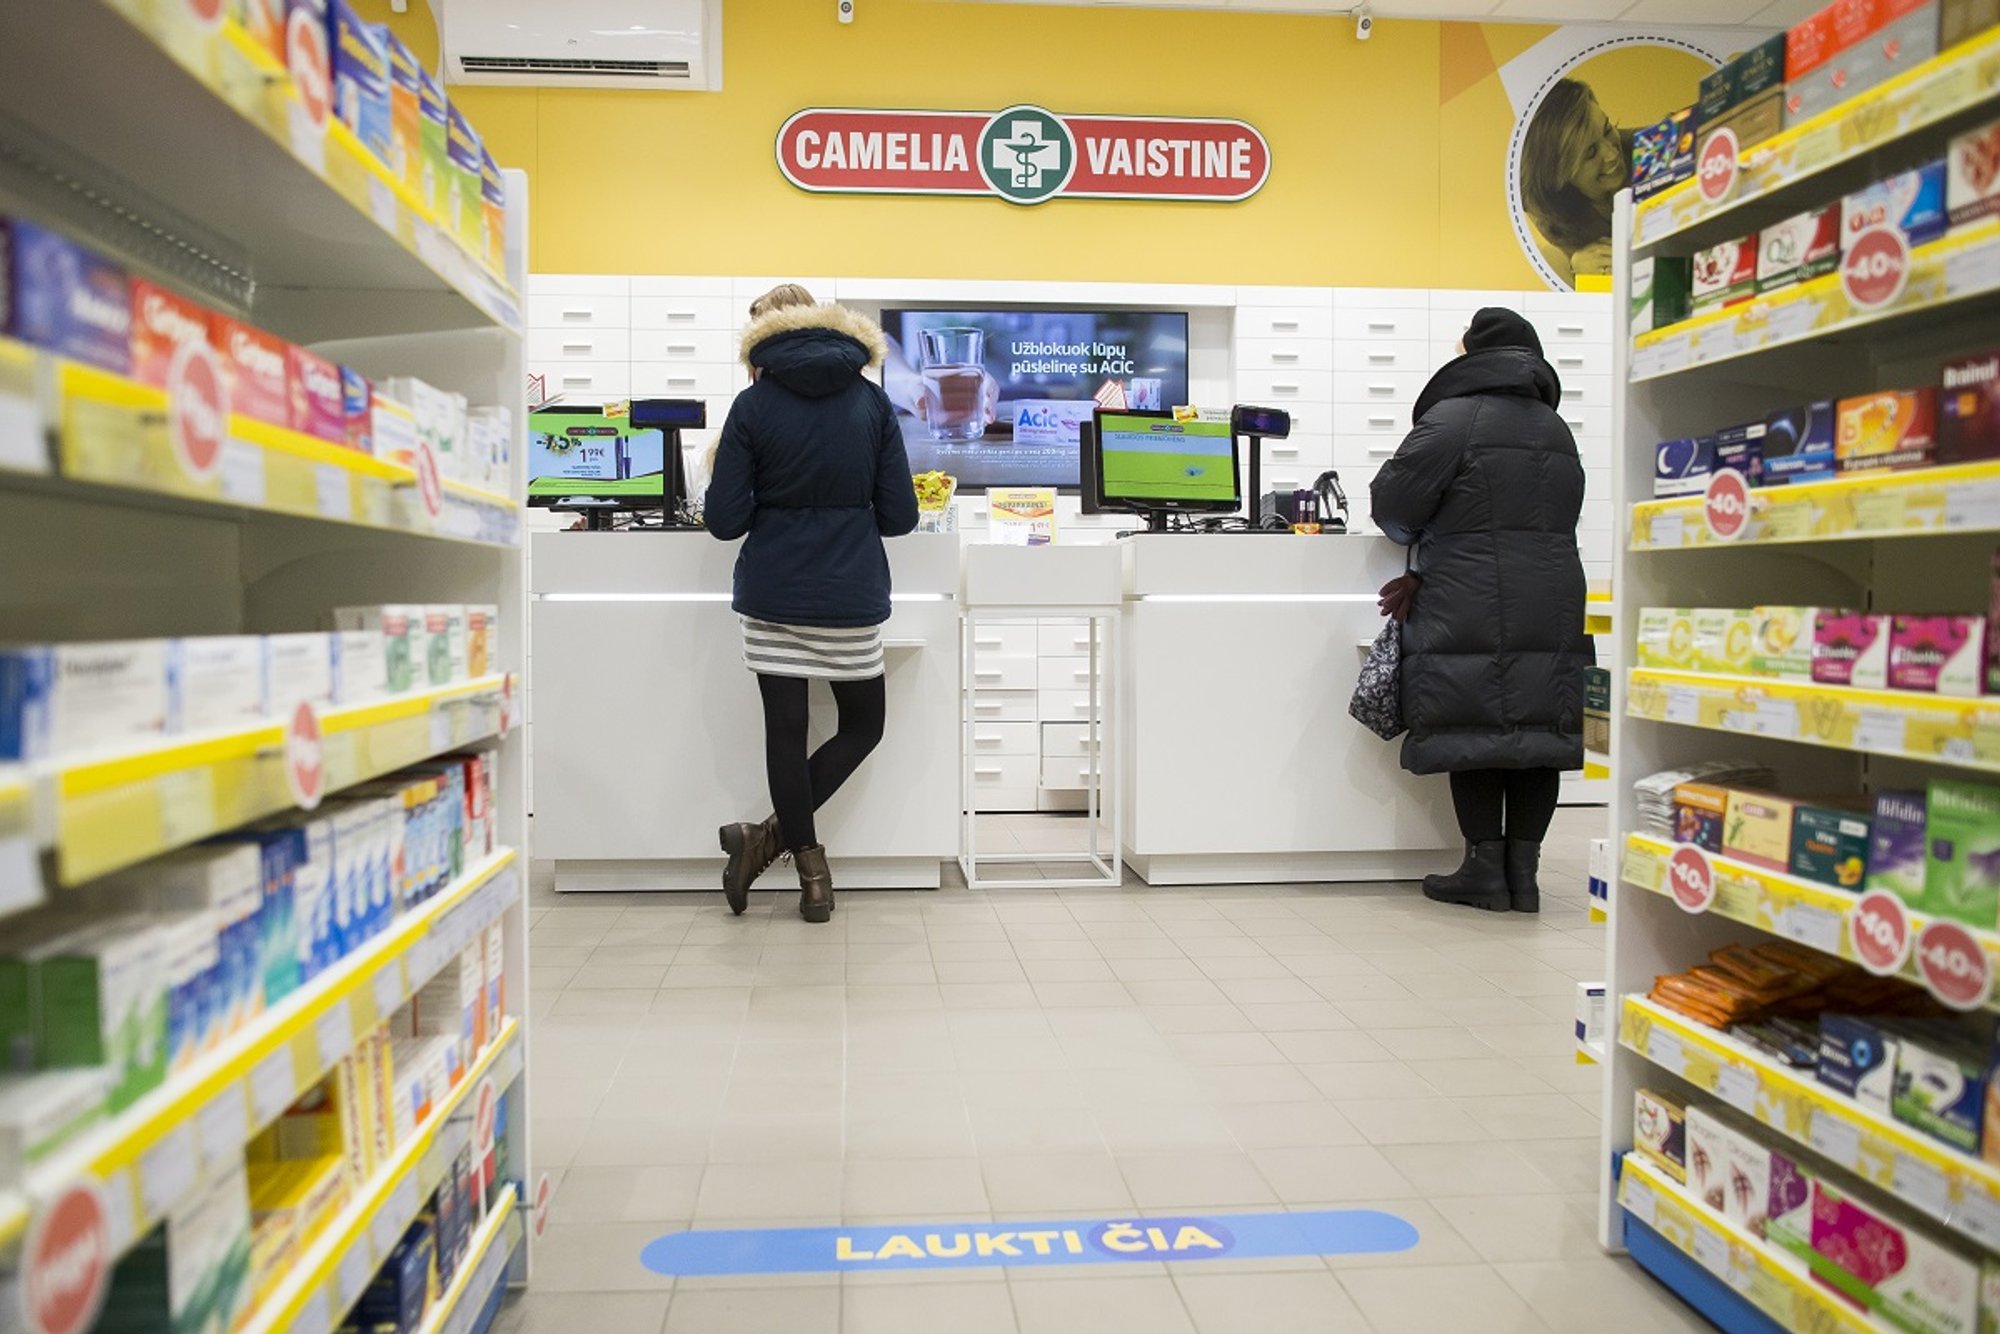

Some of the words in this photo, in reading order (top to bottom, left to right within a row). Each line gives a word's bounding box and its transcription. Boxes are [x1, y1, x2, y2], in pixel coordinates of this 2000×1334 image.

[796, 130, 969, 171] CAMELIA
[1086, 137, 1252, 179] VAISTINĖ
[1011, 342, 1090, 356] Užblokuok
[1092, 342, 1127, 359] lūpų
[1011, 360, 1078, 376] pūslelinę
[1080, 364, 1097, 374] su
[1099, 360, 1134, 374] ACIC
[1018, 408, 1058, 428] Acic
[836, 1229, 1082, 1262] LAUKTI
[1101, 1221, 1225, 1254] ČIA
